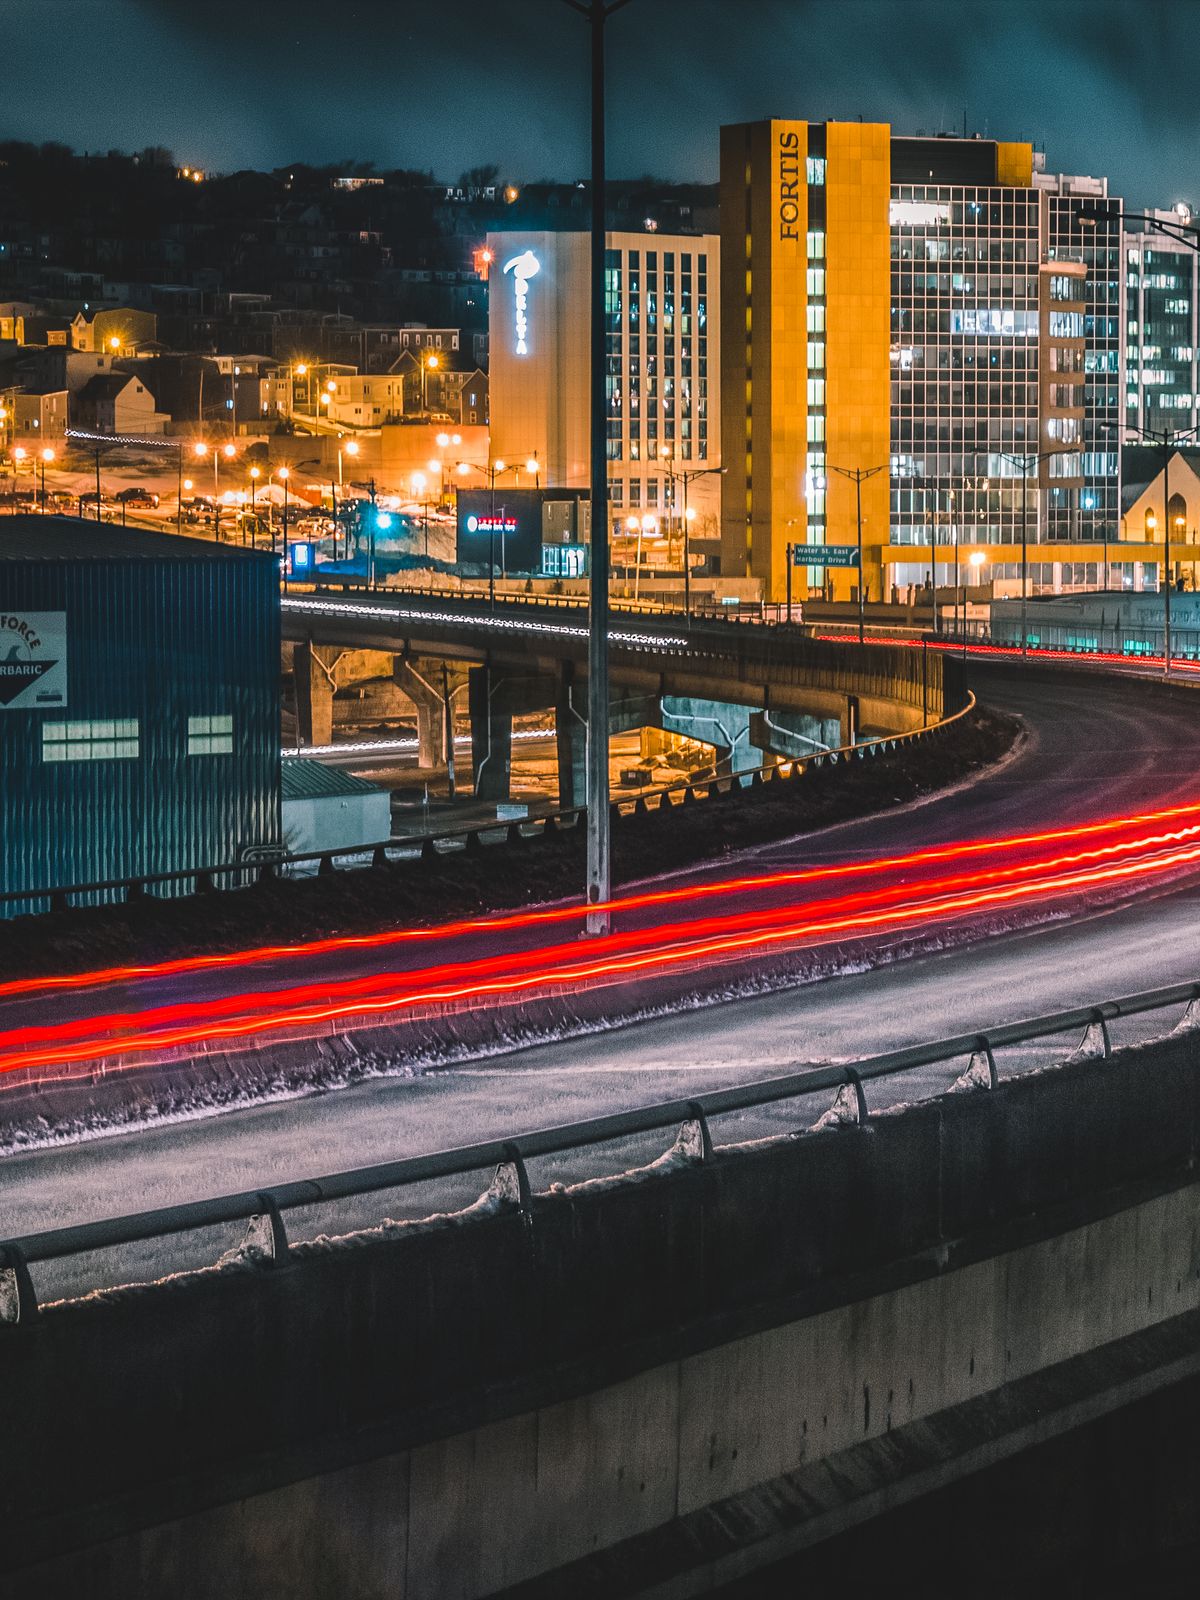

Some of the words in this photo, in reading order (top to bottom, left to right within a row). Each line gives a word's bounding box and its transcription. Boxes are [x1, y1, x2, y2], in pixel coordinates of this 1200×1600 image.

[780, 132, 799, 241] FORTIS
[515, 279, 528, 354] DELTA
[797, 547, 818, 555] Water
[821, 547, 831, 555] St.
